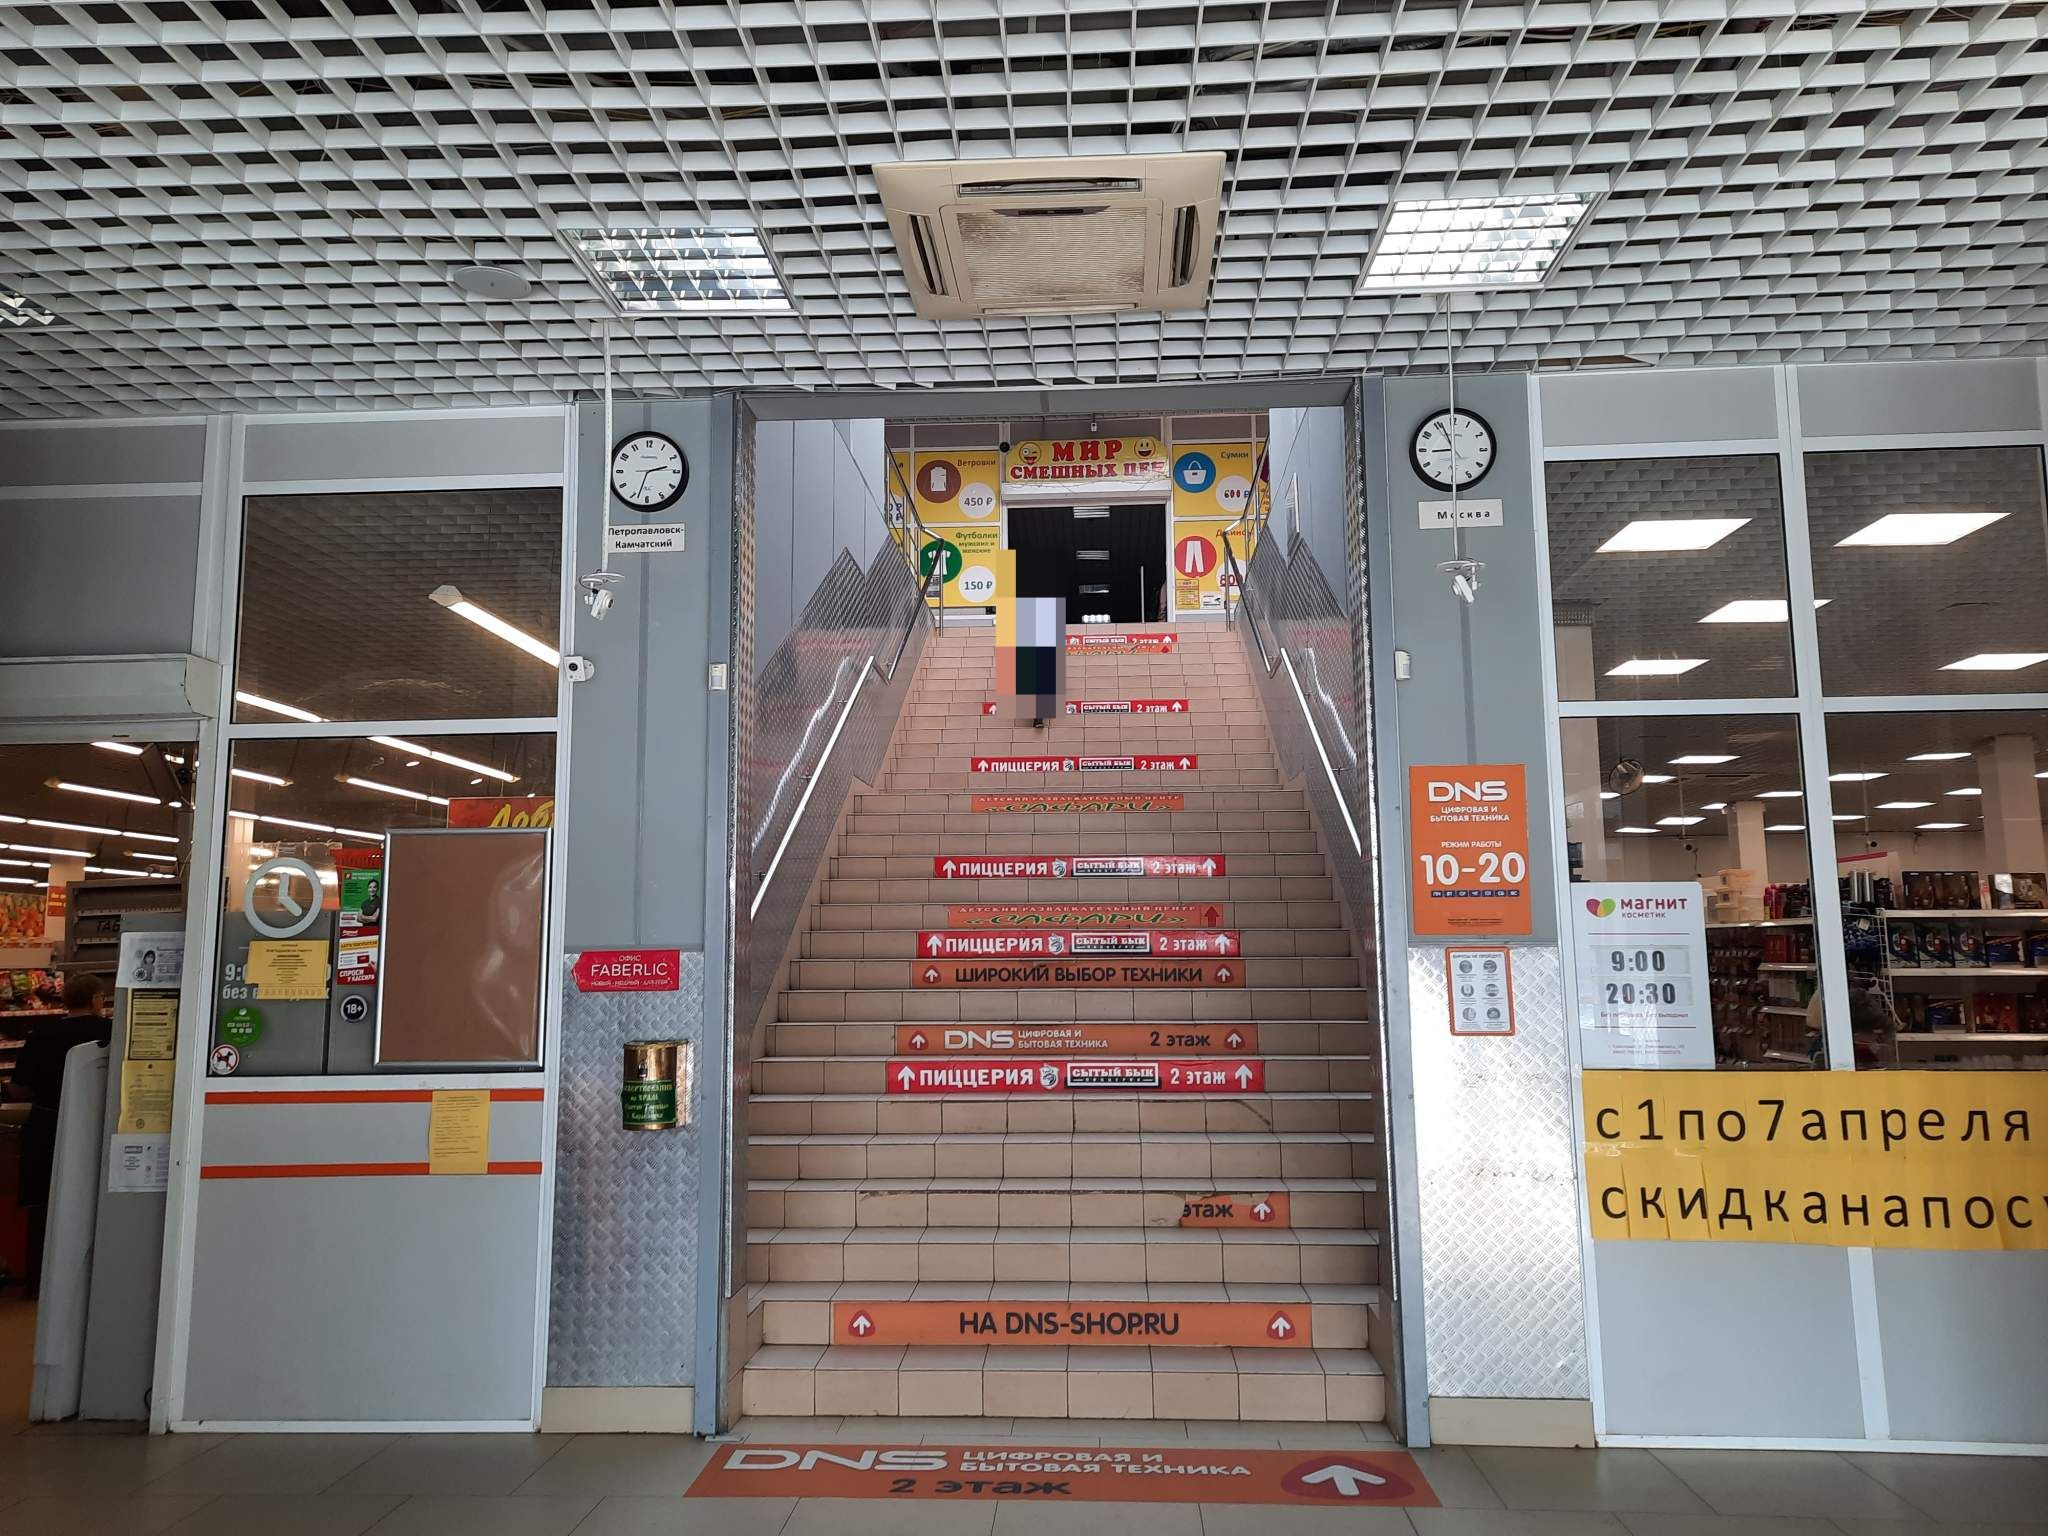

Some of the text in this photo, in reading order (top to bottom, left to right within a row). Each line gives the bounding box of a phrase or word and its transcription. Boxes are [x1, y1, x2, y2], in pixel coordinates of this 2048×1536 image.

[646, 440, 653, 448] 12
[1052, 440, 1122, 462] МИР
[1220, 451, 1249, 459] Сумки
[1010, 463, 1118, 480] СМЕШНЫХ
[963, 497, 984, 507] 450
[1437, 511, 1490, 519] Москва
[608, 527, 684, 537] Петропавловск-
[955, 531, 999, 540] Футболки
[615, 538, 673, 549] Камчатский
[964, 581, 984, 590] 150
[1136, 703, 1143, 713] 2
[1145, 704, 1168, 713] этаж
[991, 760, 1060, 773] ПИЦЦЕРИЯ
[1140, 760, 1147, 771] 2
[1150, 761, 1175, 771] этаж
[1428, 780, 1508, 802] DNS
[1441, 806, 1489, 814] ЦИФРОВАЯ
[1472, 814, 1510, 822] ТЕХНИКА
[1471, 840, 1502, 848] РАБОТЫ
[959, 861, 1047, 877] ПИЦЦЕРИЯ
[1153, 861, 1161, 874] 2
[1164, 862, 1197, 875] этаж
[1420, 852, 1526, 885] 10-20
[945, 935, 1208, 954] ПИЦЦЕРИЯ СЫТЫЙ БЫК 2 этаж
[1611, 950, 1665, 972] 9:00
[591, 962, 668, 977] FABERLIC
[955, 966, 1202, 982] ШИРОКИЙ ВЫБОР ТЕХНИКИ
[222, 984, 248, 999] без
[1606, 983, 1676, 1004] 20:30
[346, 1003, 363, 1014] 18+
[944, 1029, 1082, 1049] DNS ЦИФРОВАЯ И
[1017, 1039, 1108, 1049] БЫТОВАЯ ТЕХНИКА
[1150, 1031, 1211, 1047] 2 этаж
[919, 1066, 1226, 1088] ПИЦЦЕРИЯ СЫТЫЙ БЫК 2 этаж
[1181, 1200, 1233, 1219] этаж
[959, 1312, 1180, 1336] НА DNS-SHOP.RU
[722, 1449, 1164, 1472] DNS ЦИФРОВАЯ И
[959, 1461, 1252, 1475] БЫТОВАЯ ТЕХНИКА
[888, 1479, 1072, 1495] 2 этаж
